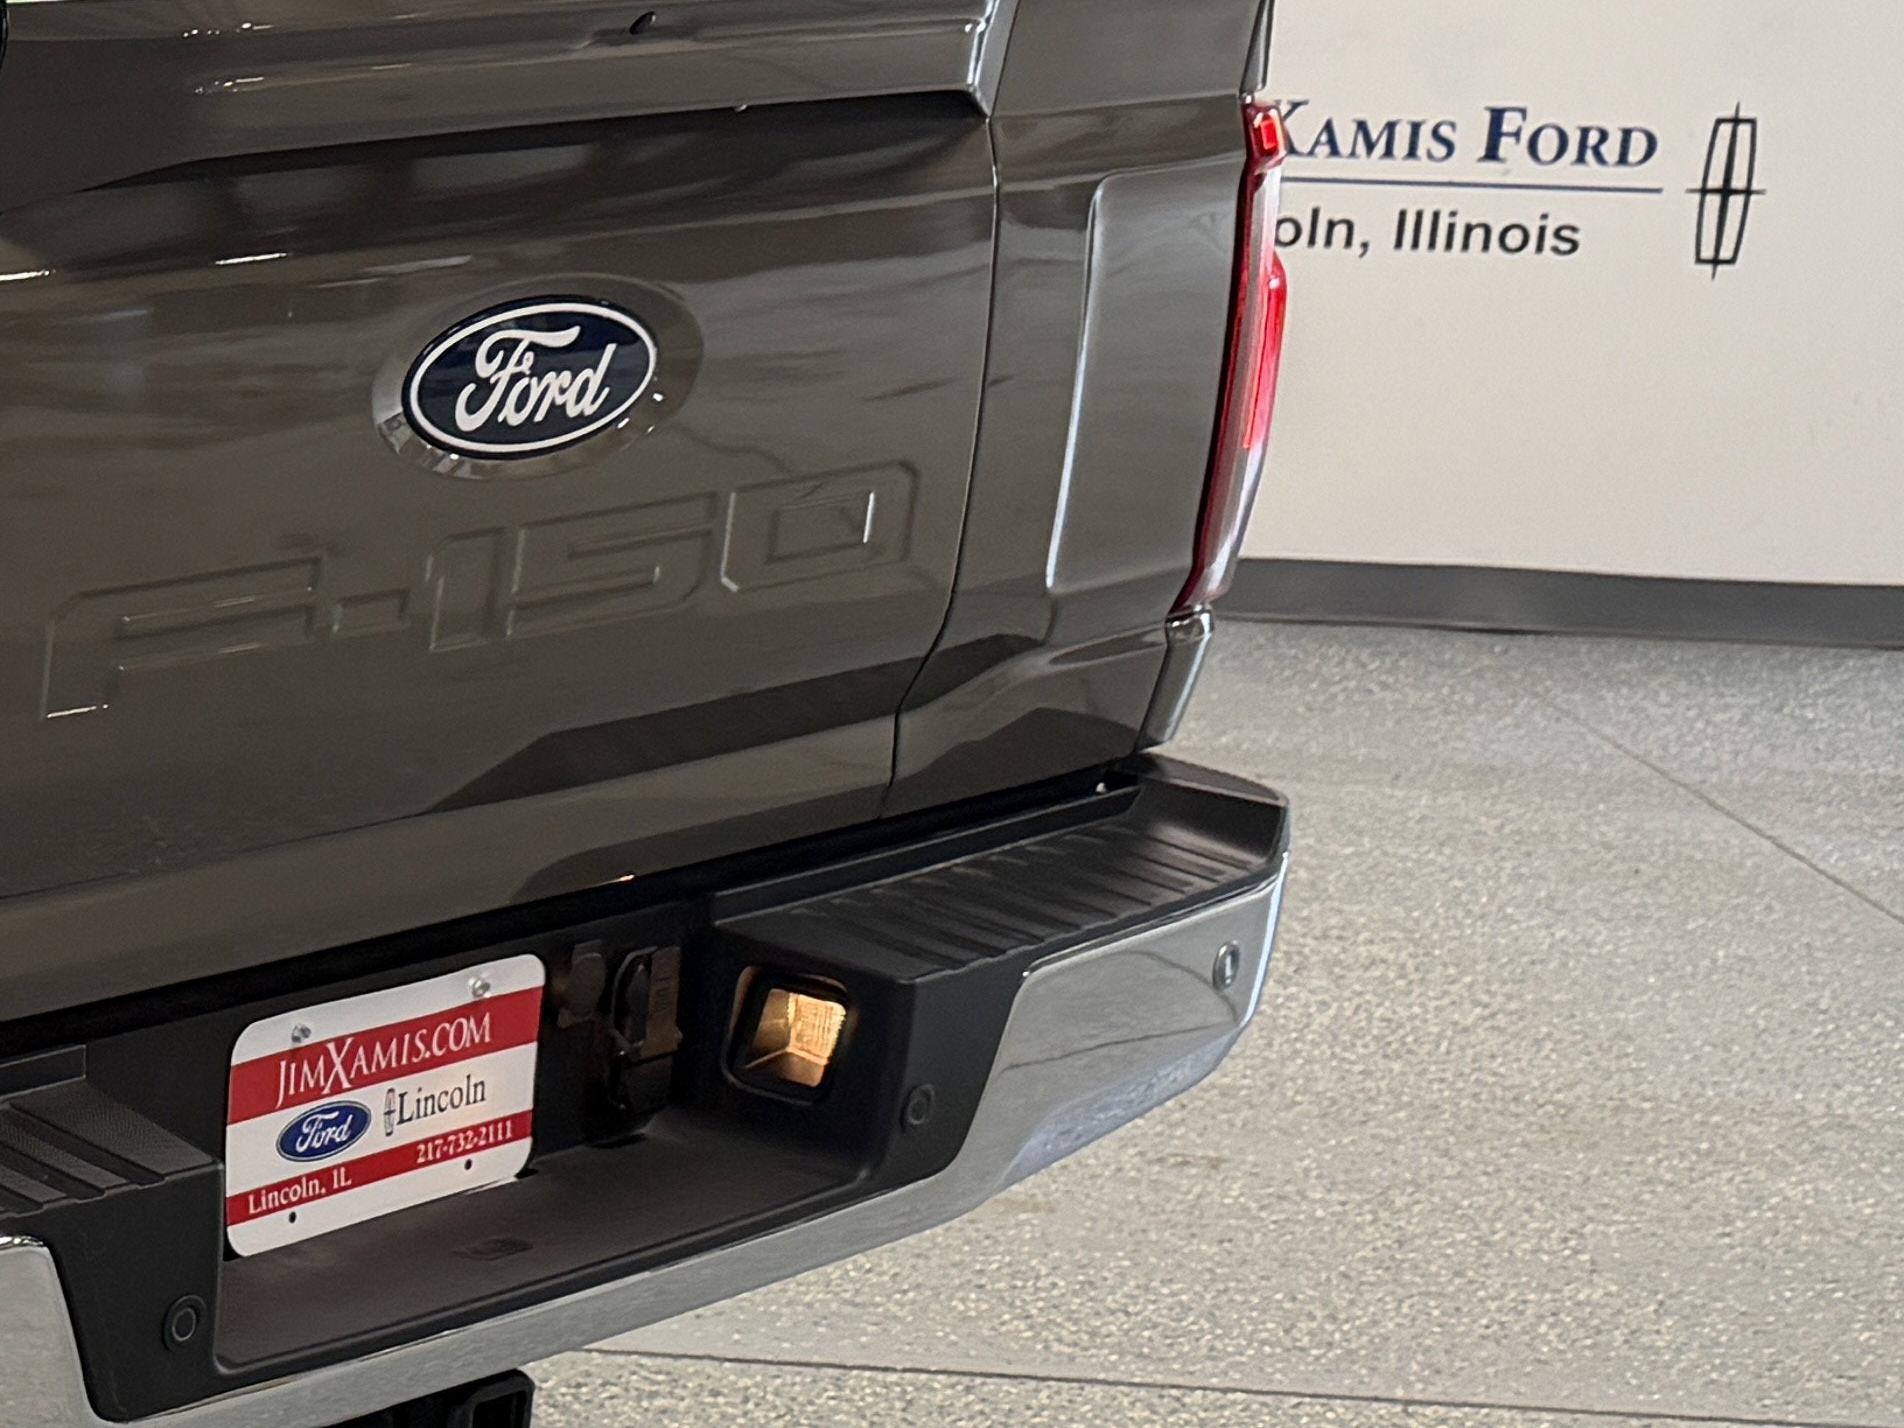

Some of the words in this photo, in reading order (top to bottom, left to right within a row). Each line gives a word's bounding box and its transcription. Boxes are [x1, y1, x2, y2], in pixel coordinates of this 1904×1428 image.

[1475, 105, 1659, 168] FORD
[1393, 208, 1582, 257] Illinois
[453, 324, 618, 434] Ford
[276, 1012, 492, 1109] JIMXAMIS.COM
[396, 1073, 486, 1126] Lincoln
[295, 1107, 354, 1154] Ford
